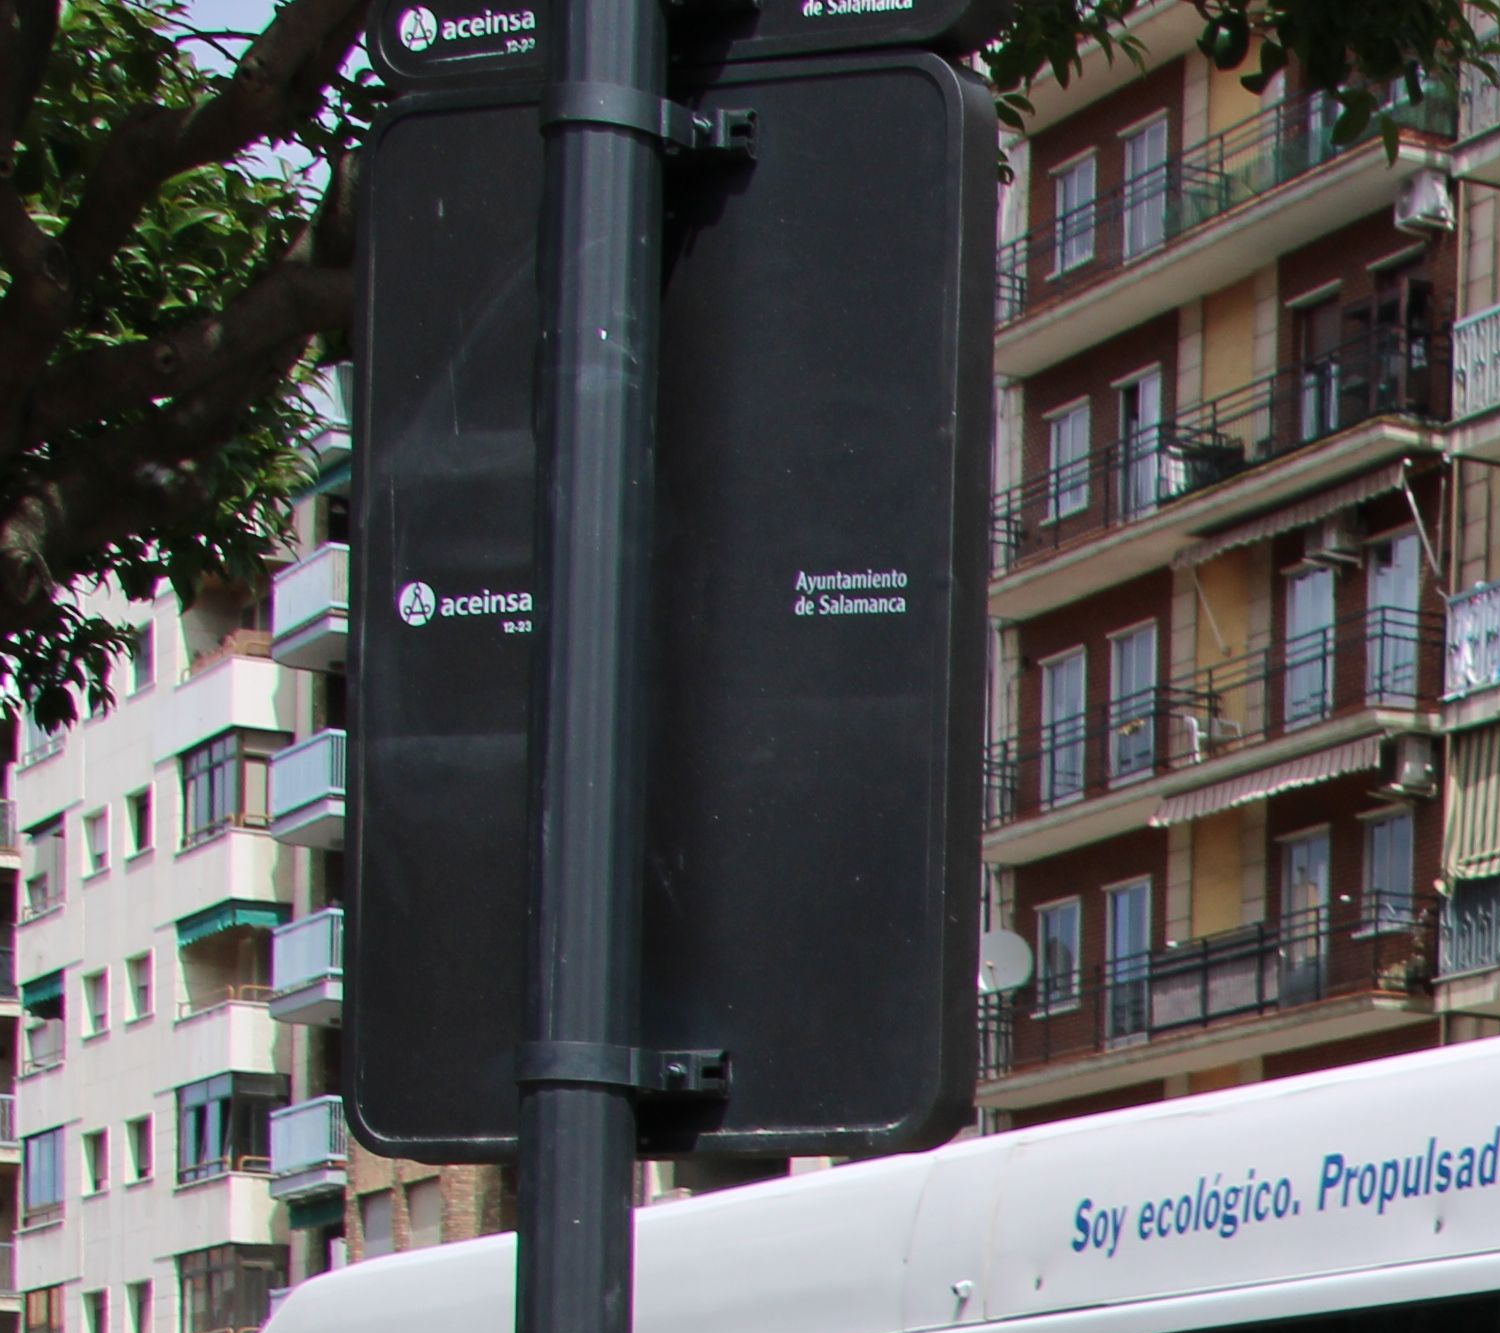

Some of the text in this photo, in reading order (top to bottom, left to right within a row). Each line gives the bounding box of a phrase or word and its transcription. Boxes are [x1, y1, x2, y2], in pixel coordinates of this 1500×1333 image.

[441, 9, 536, 41] aceinsa
[795, 568, 908, 595] Ayuntamiento
[440, 588, 533, 617] aceinsa
[794, 593, 907, 616] de Salamanca
[503, 619, 533, 634] 12-23
[1070, 1197, 1128, 1259] Soy
[1137, 1167, 1301, 1240] ecológico.
